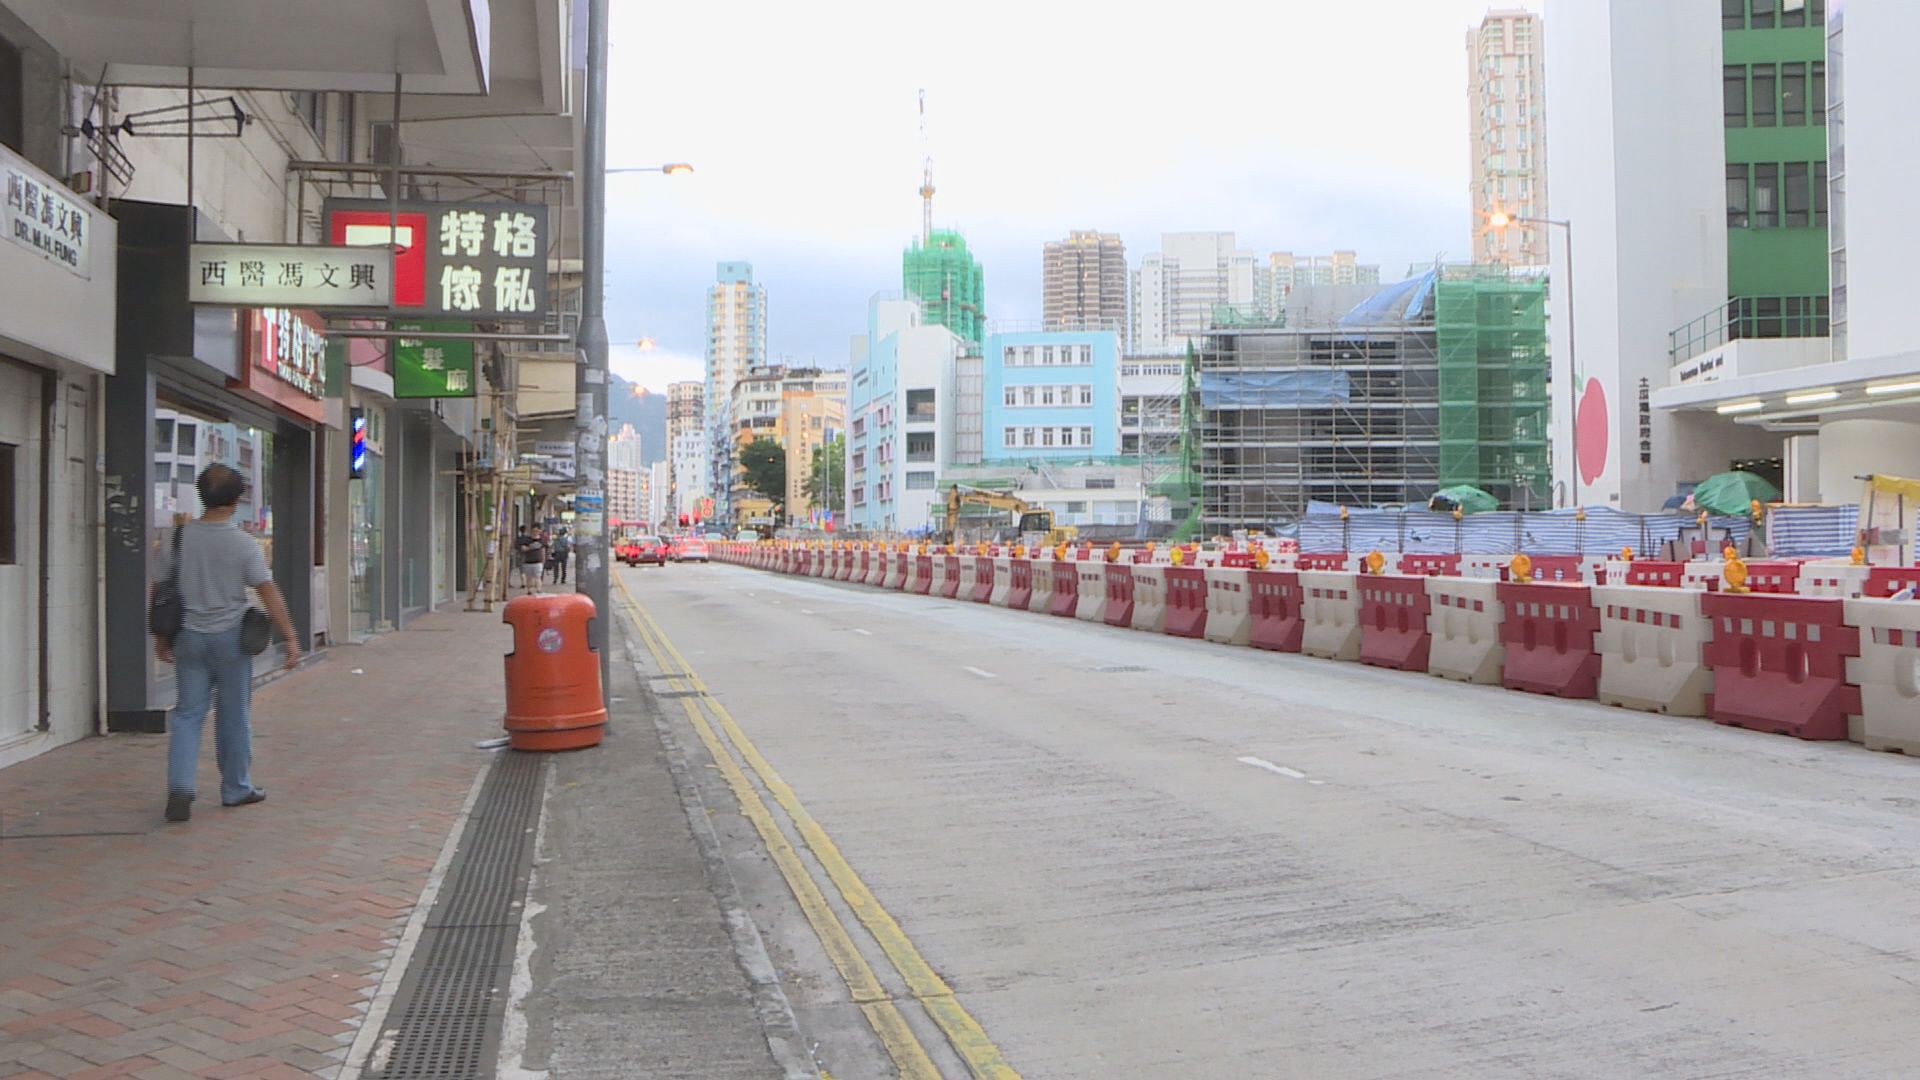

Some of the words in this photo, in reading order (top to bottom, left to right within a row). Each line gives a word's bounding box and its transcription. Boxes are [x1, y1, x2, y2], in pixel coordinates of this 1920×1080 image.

[7, 170, 82, 247] 西醫馮文興
[55, 240, 77, 267] FUNG
[440, 210, 536, 257] 特格
[200, 260, 375, 290] 西醫馮文興
[440, 265, 536, 312] 傢俬
